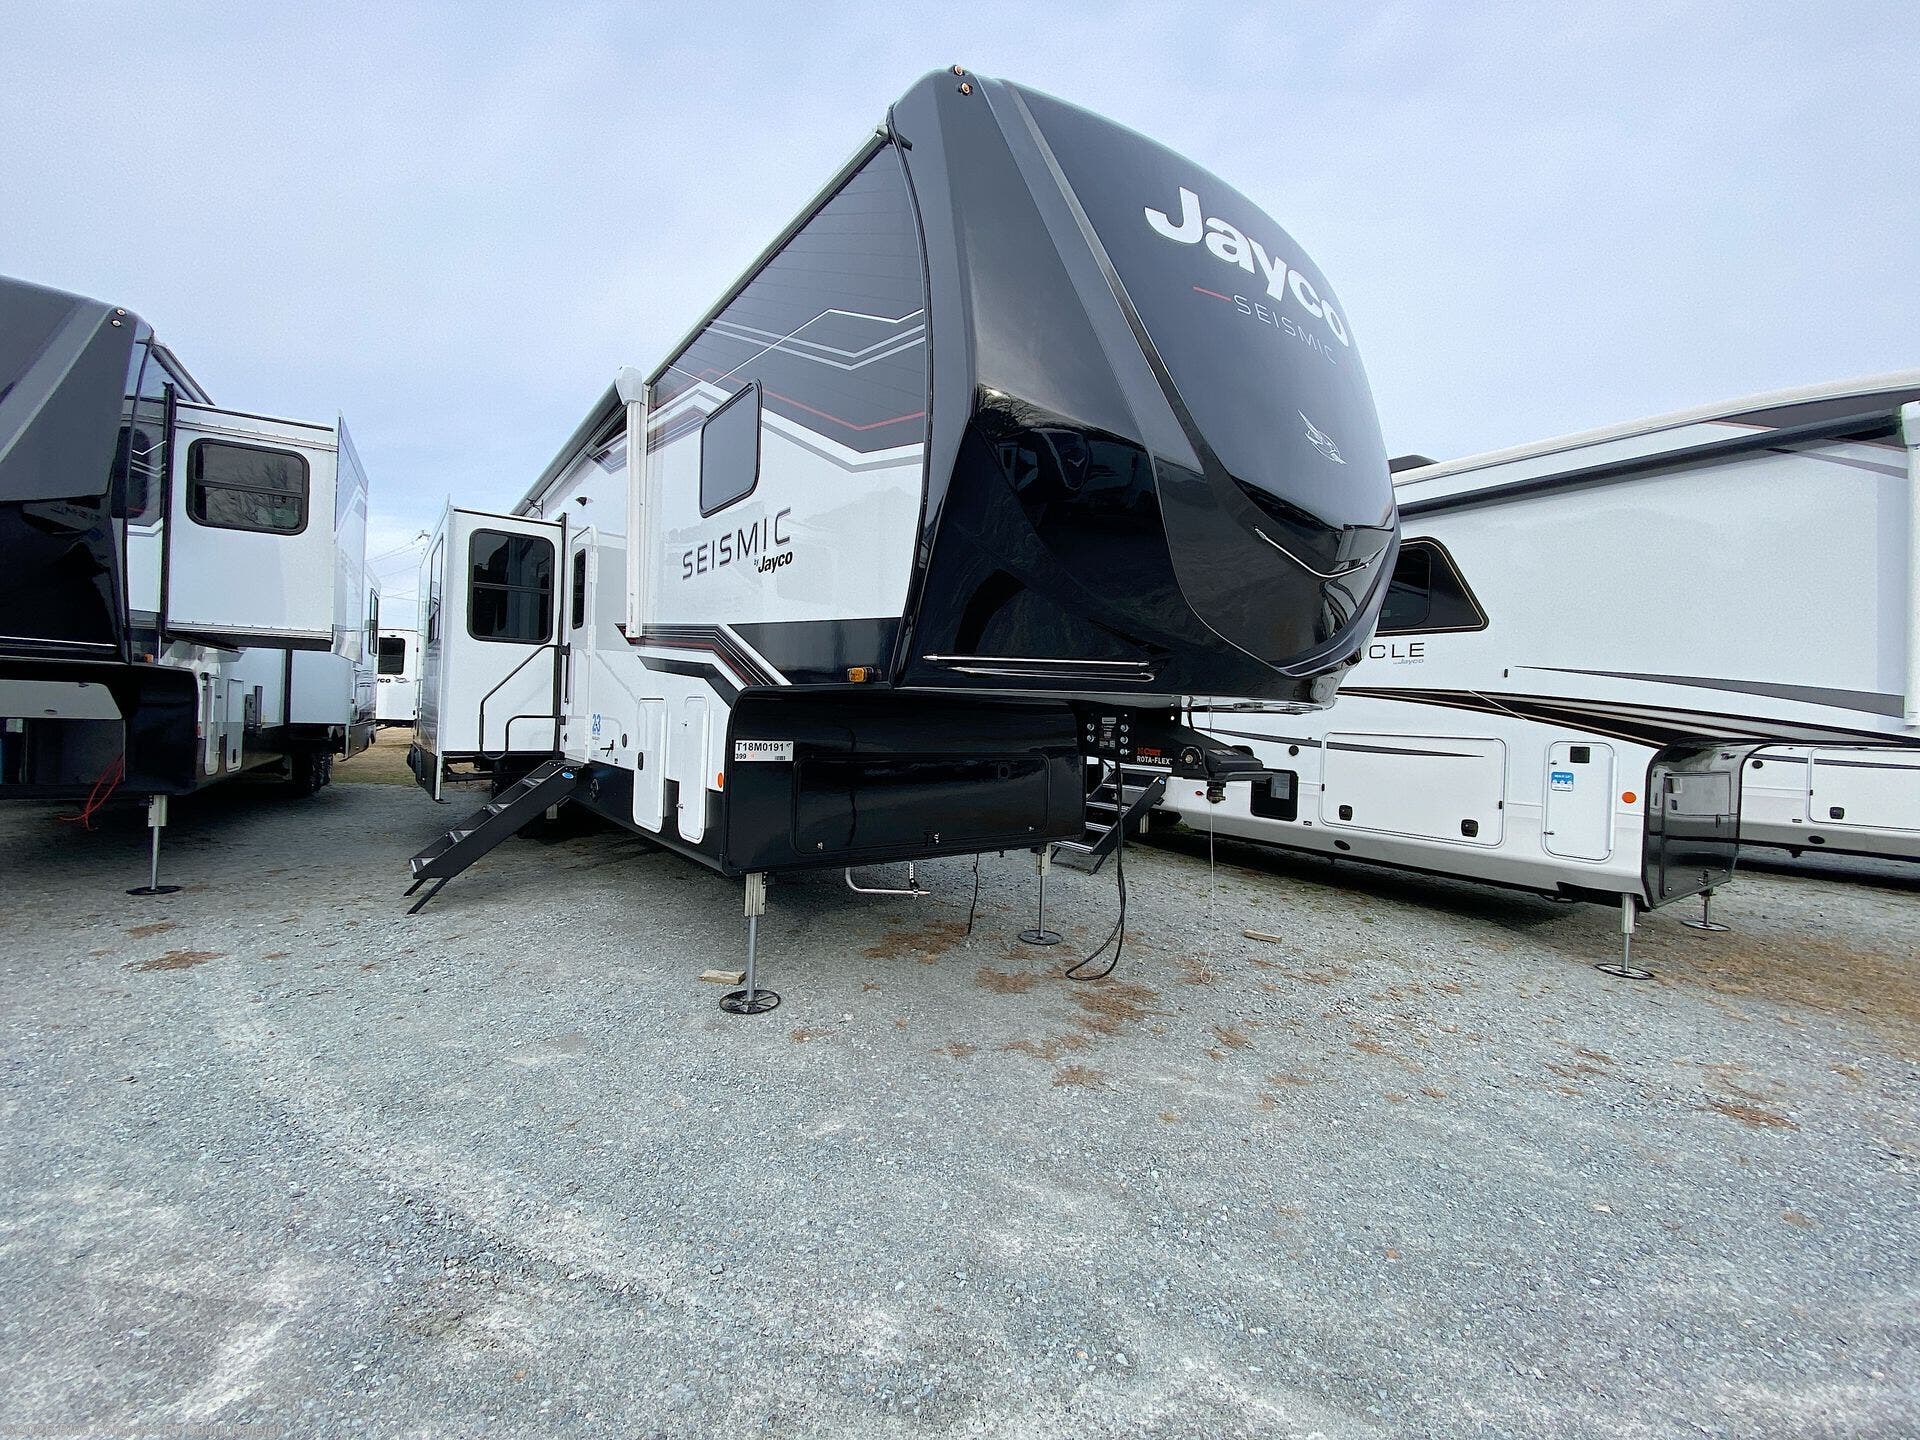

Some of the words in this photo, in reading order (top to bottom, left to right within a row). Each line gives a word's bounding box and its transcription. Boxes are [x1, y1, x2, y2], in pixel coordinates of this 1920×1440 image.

[1144, 186, 1349, 347] Jayco
[1232, 295, 1336, 364] SEISMIC
[682, 507, 791, 580] SEISMIC
[758, 551, 793, 573] Jayco
[736, 742, 784, 751] T18M0191
